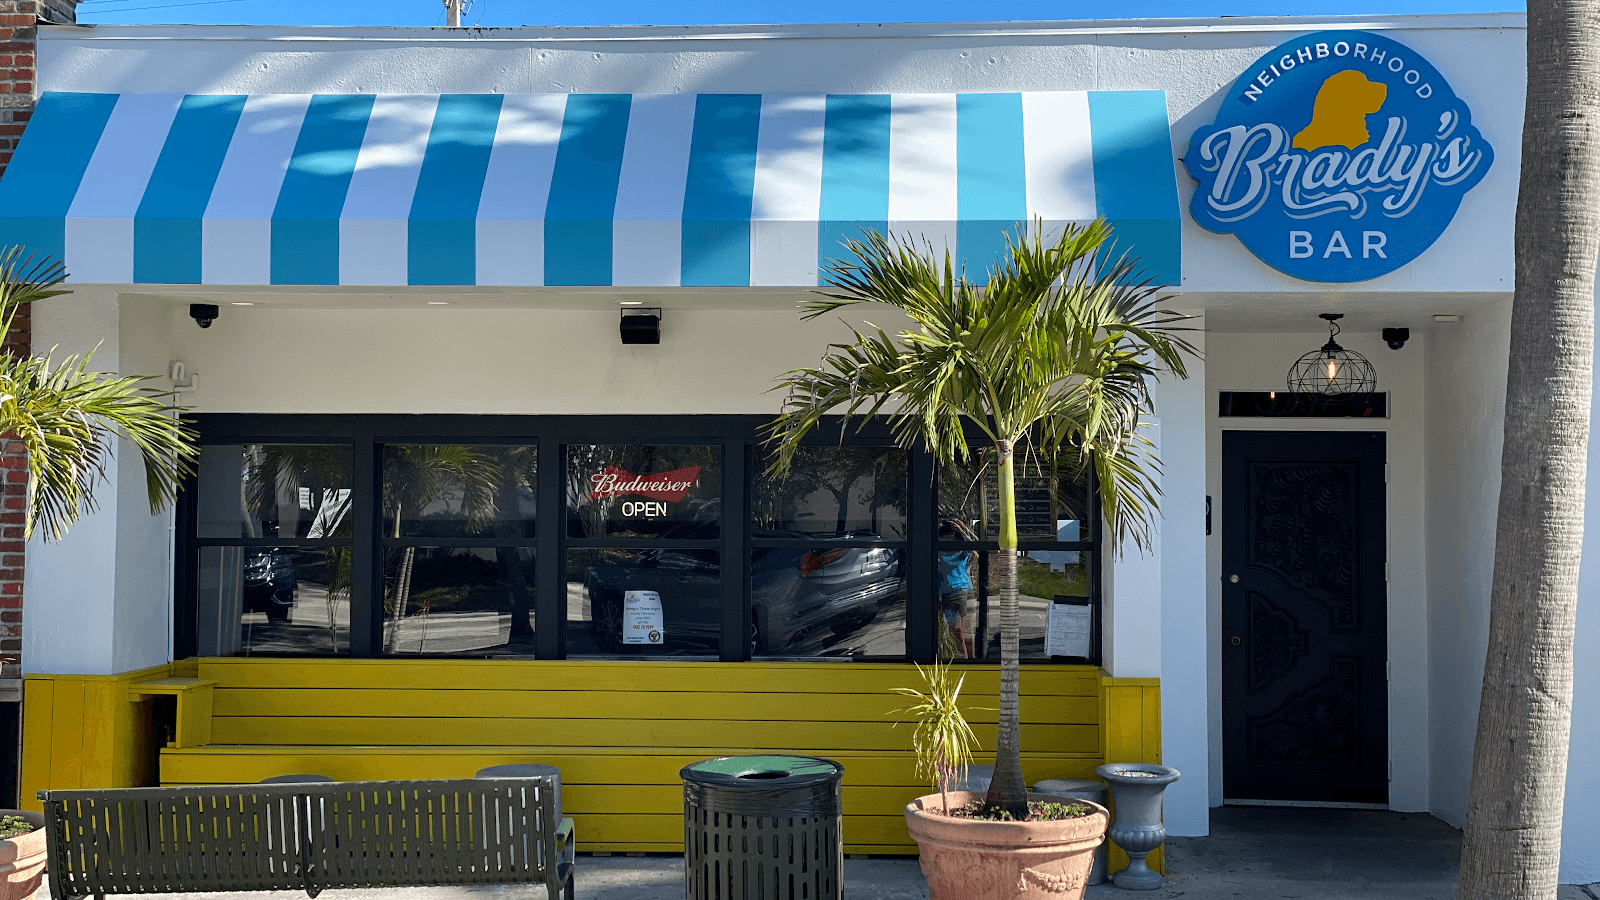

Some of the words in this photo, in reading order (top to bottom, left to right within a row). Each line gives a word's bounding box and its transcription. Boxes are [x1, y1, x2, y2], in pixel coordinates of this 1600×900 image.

[1244, 41, 1433, 102] NEIGHBORHOOD
[1200, 109, 1482, 222] Brady's
[1289, 230, 1388, 259] BAR
[590, 473, 692, 493] Budweiser
[622, 501, 667, 517] OPEN
